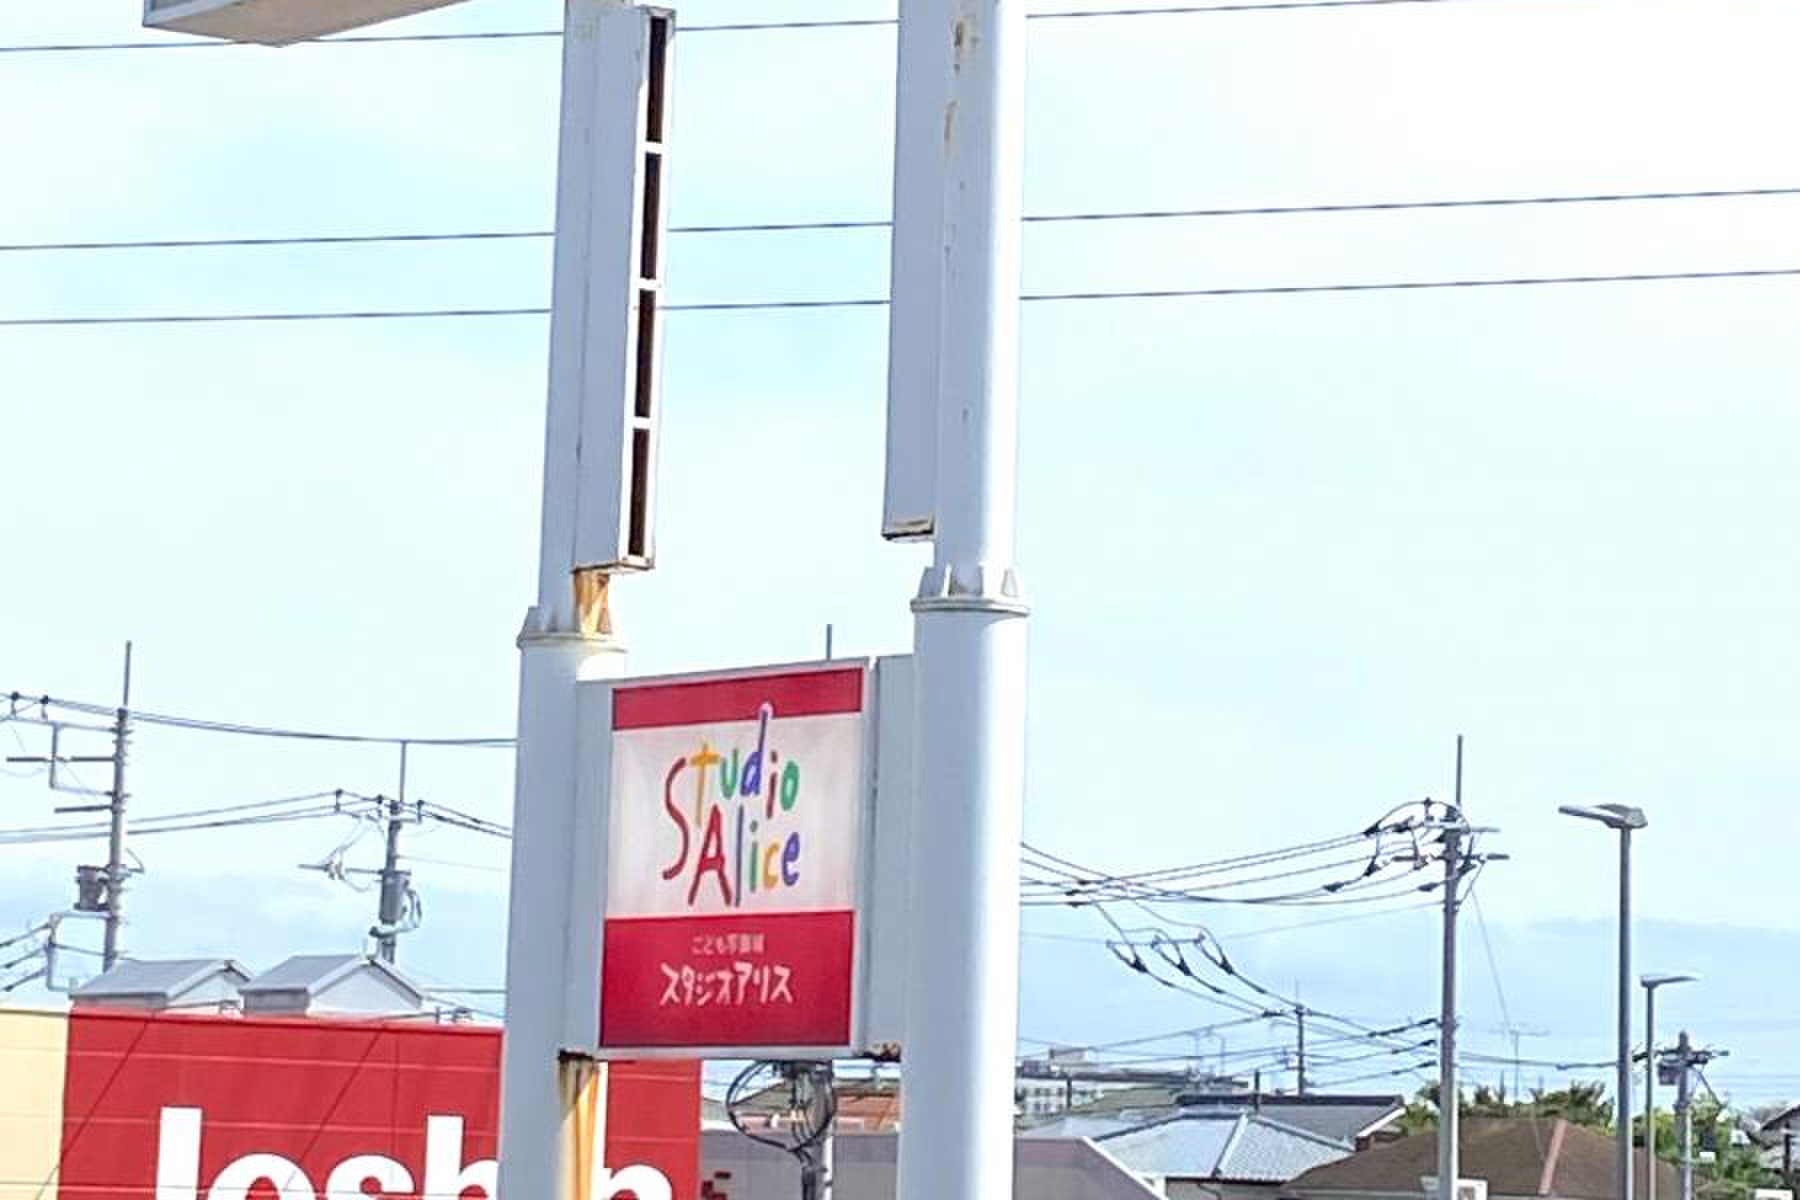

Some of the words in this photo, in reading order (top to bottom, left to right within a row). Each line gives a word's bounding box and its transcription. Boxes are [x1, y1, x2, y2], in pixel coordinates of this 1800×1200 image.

[662, 707, 799, 881] Studio
[687, 804, 800, 907] Alice
[659, 961, 794, 1006] スタジオアリス
